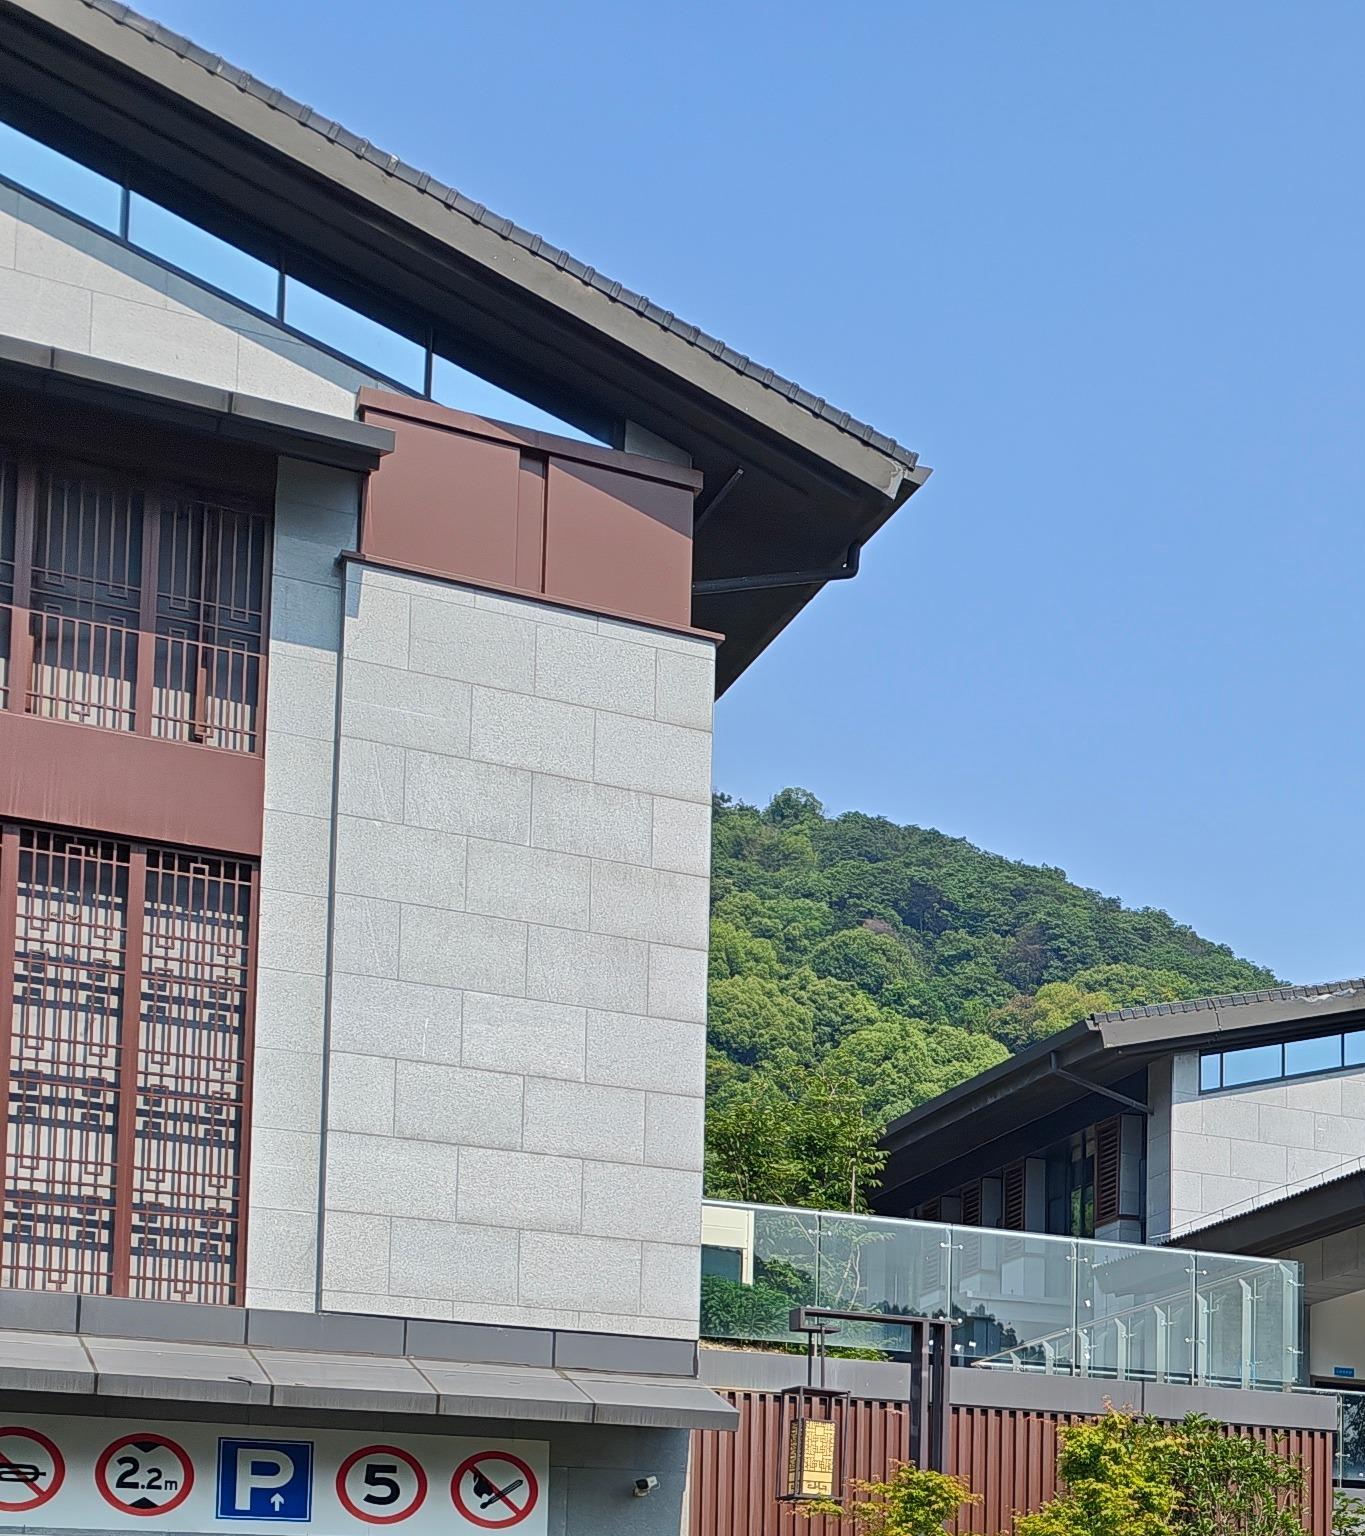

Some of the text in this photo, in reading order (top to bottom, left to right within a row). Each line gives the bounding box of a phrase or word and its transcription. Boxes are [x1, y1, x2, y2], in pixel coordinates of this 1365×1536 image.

[116, 1456, 178, 1490] 2.2m
[235, 1448, 294, 1511] P
[362, 1464, 400, 1505] 5
